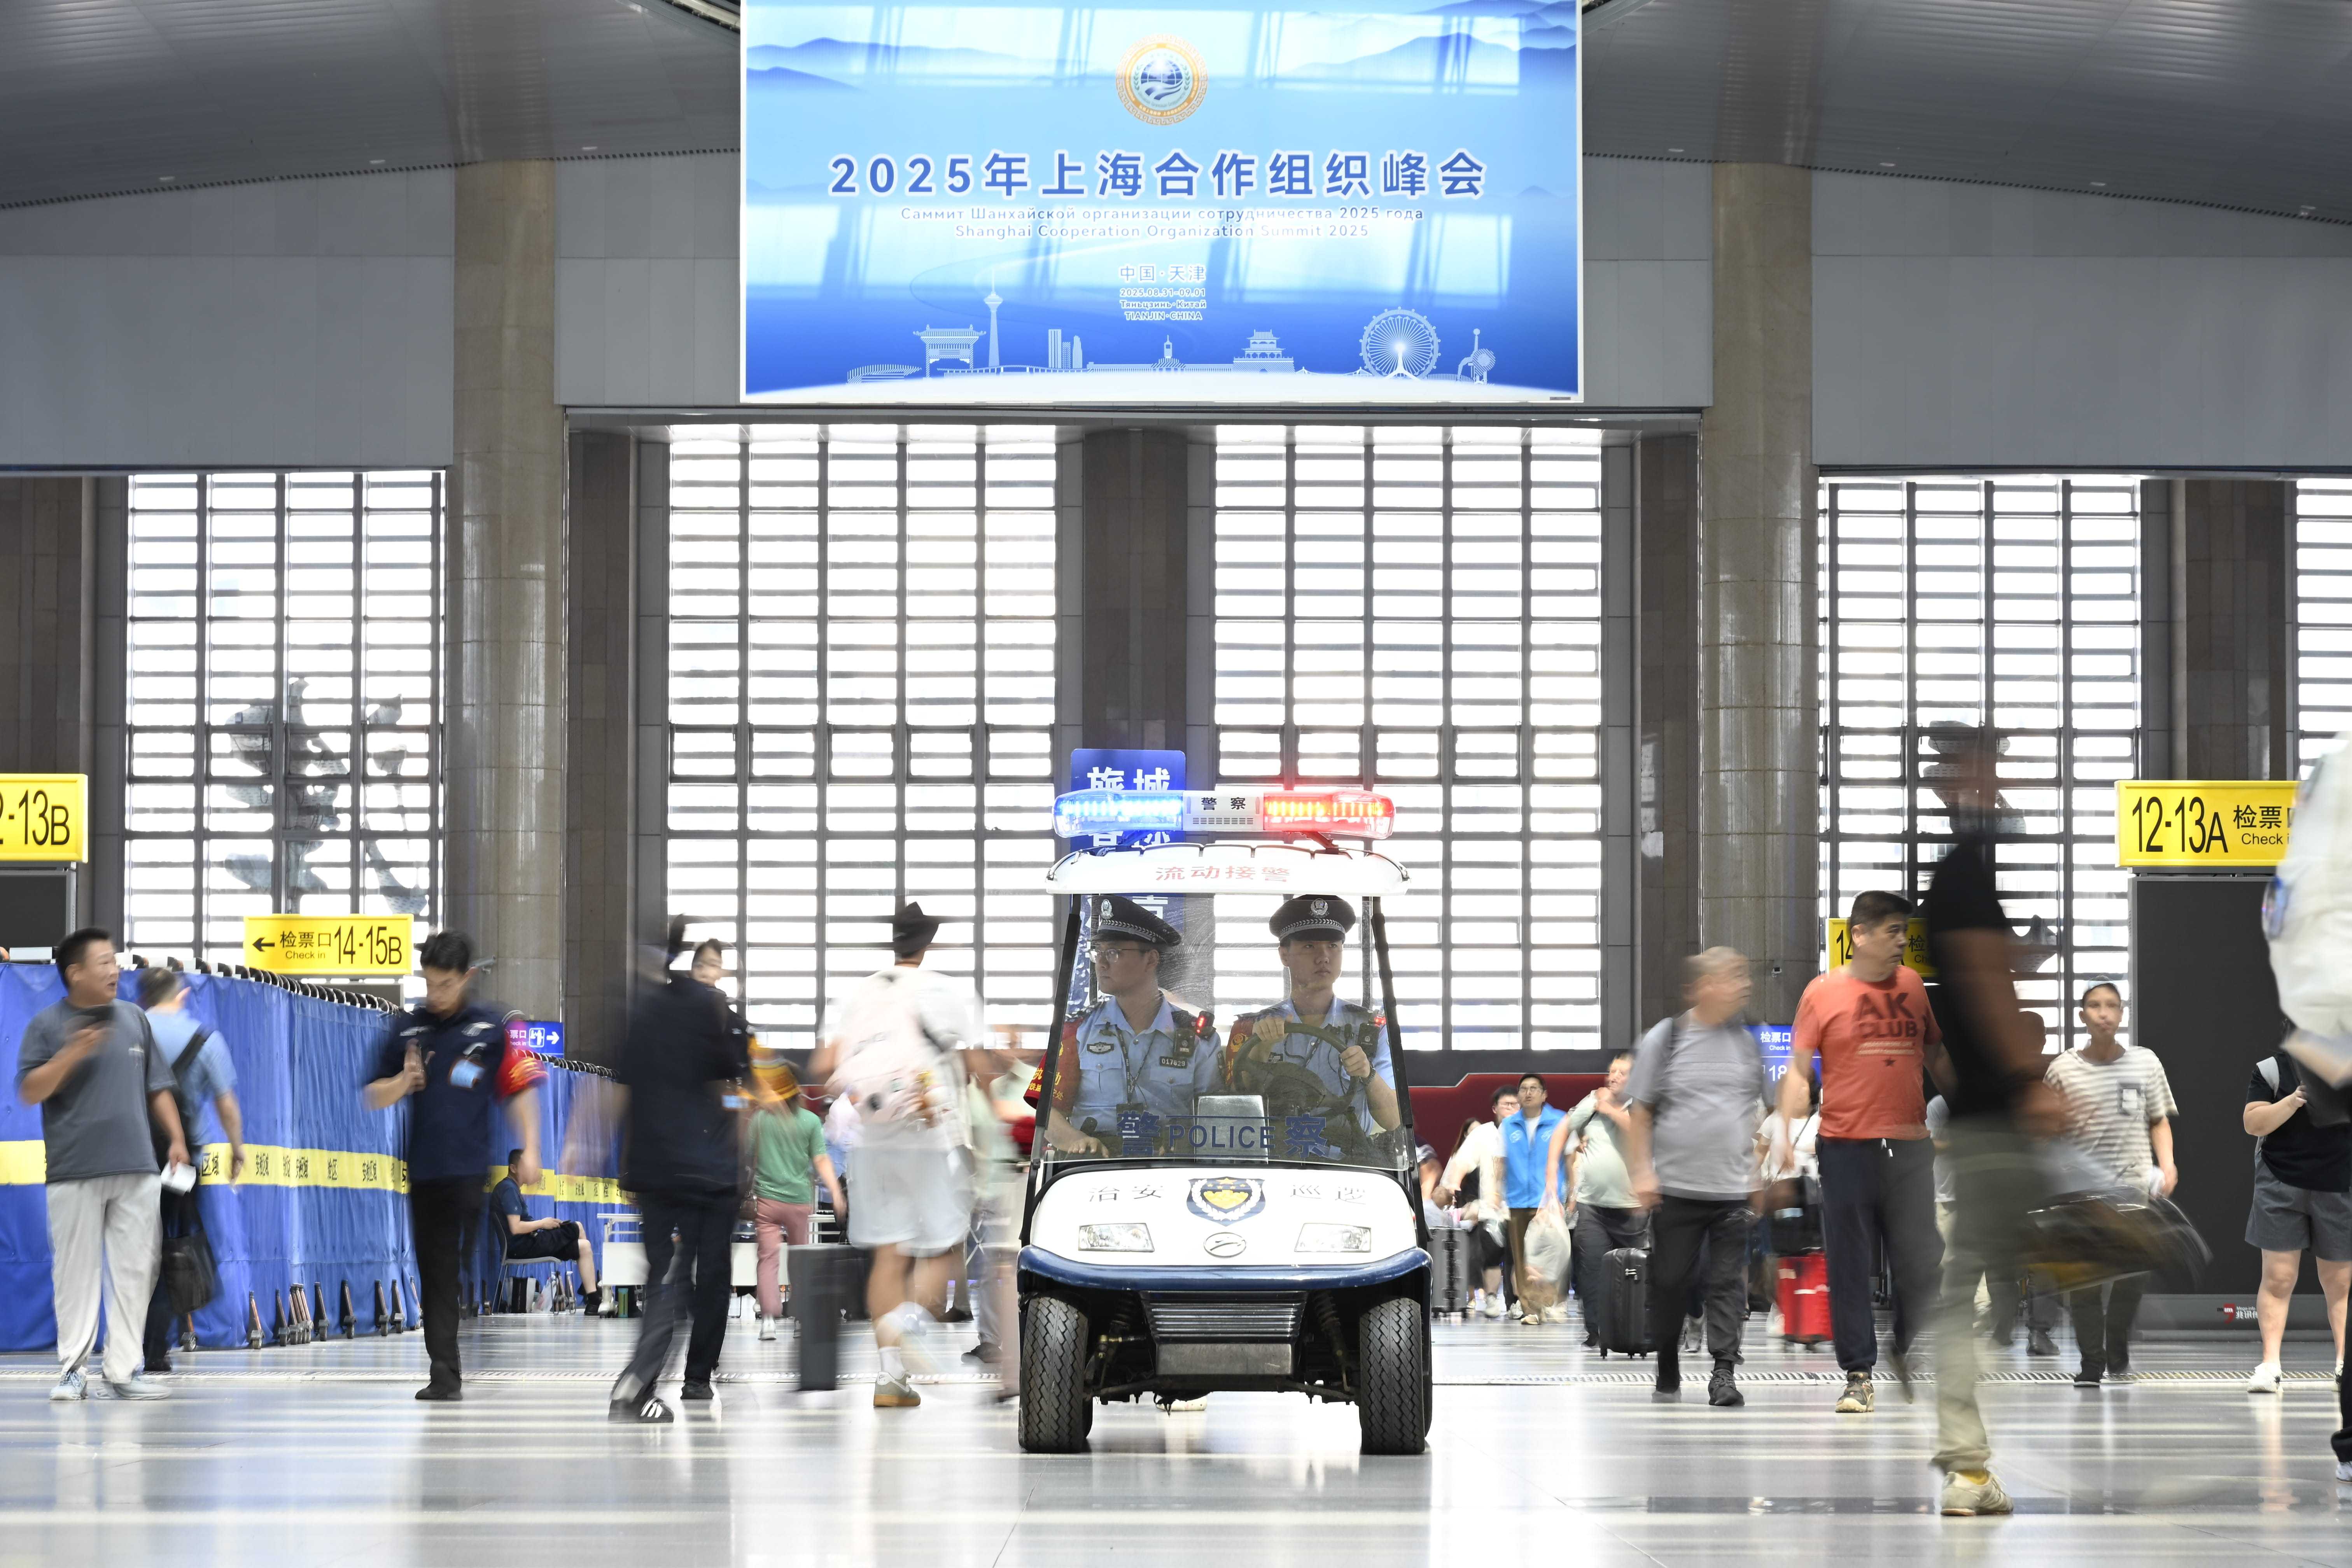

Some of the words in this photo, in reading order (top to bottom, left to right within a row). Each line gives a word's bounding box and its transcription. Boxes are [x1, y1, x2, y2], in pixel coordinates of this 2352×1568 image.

[831, 151, 1483, 196] 2025年上海合作组织峰会
[901, 208, 965, 219] Саммит
[971, 207, 1074, 219] Шанхайской
[1083, 209, 1195, 222] организации
[1199, 209, 1332, 222] сотрудничества
[1340, 208, 1379, 219] 2025
[1386, 210, 1423, 220] года
[956, 225, 1031, 240] Shanghai
[1038, 225, 1140, 239] Cooperation
[1148, 225, 1254, 240] Organization
[1261, 225, 1322, 236] Summit
[1330, 225, 1368, 236] 2025
[1201, 797, 1246, 810] 警察
[2132, 796, 2229, 853] 12-13A
[2233, 805, 2295, 829] 检票
[2241, 833, 2283, 845] Check
[1156, 866, 1290, 882] 流动接警
[280, 931, 331, 948] 检票口
[334, 925, 402, 965] 14-15B
[285, 950, 315, 959] Check
[1760, 1031, 1791, 1043] 检票口
[1116, 1110, 1160, 1156] 警
[1169, 1125, 1276, 1149] POLICE
[1283, 1113, 1328, 1158] 察
